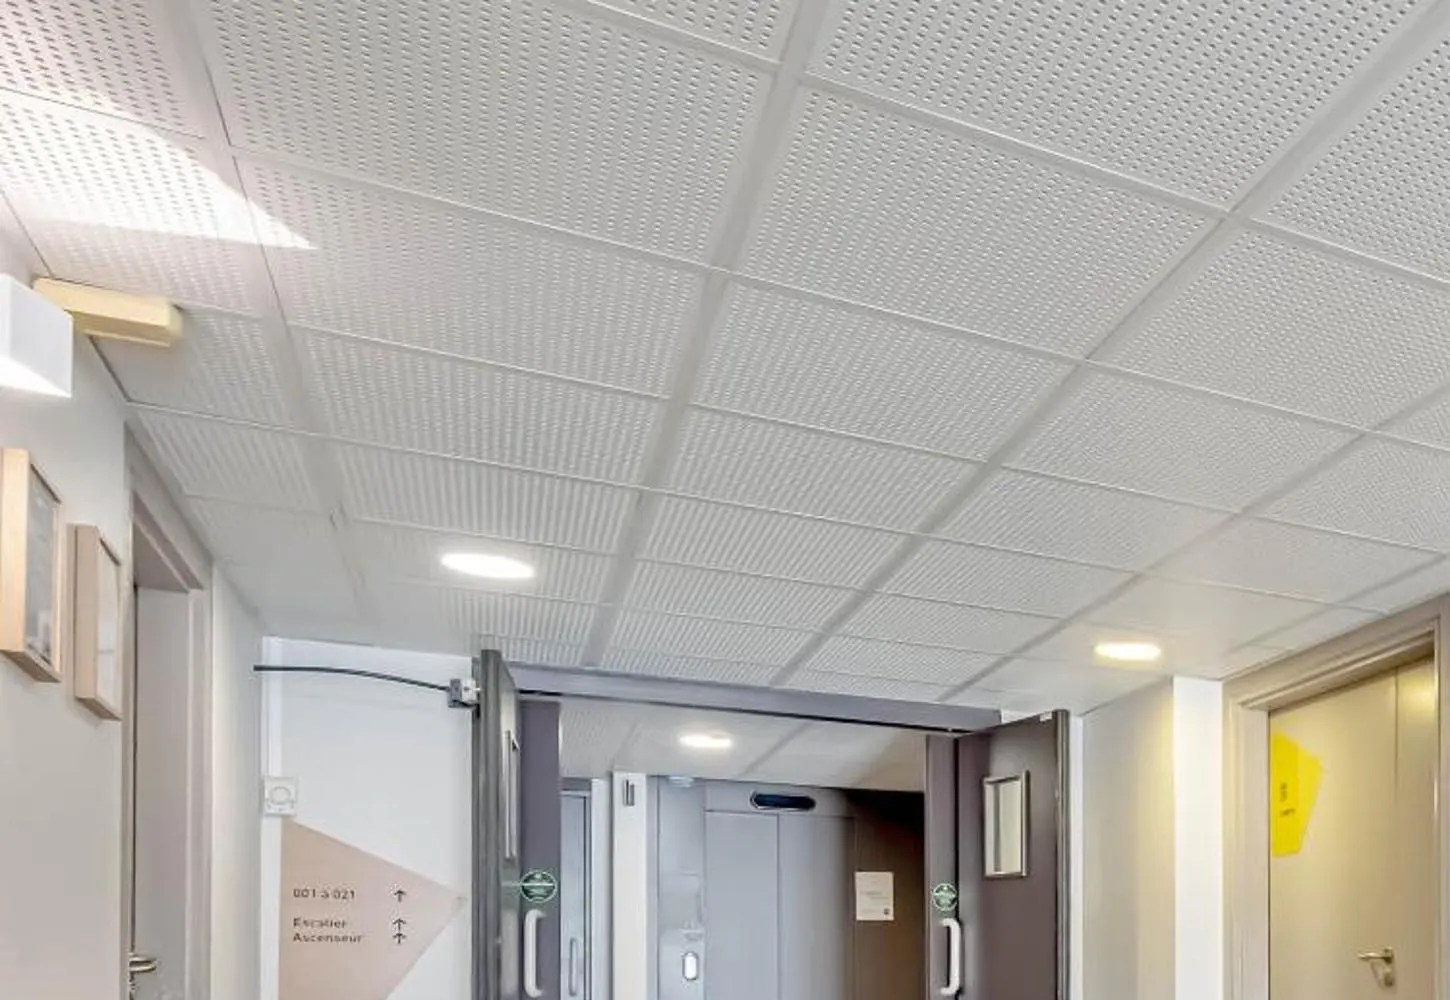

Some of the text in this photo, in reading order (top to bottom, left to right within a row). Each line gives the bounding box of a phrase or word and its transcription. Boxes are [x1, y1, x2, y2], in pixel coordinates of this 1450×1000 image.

[293, 889, 316, 898] 001
[333, 889, 355, 900] 021
[293, 918, 347, 928] Escalier
[293, 933, 361, 943] Ascenseur
